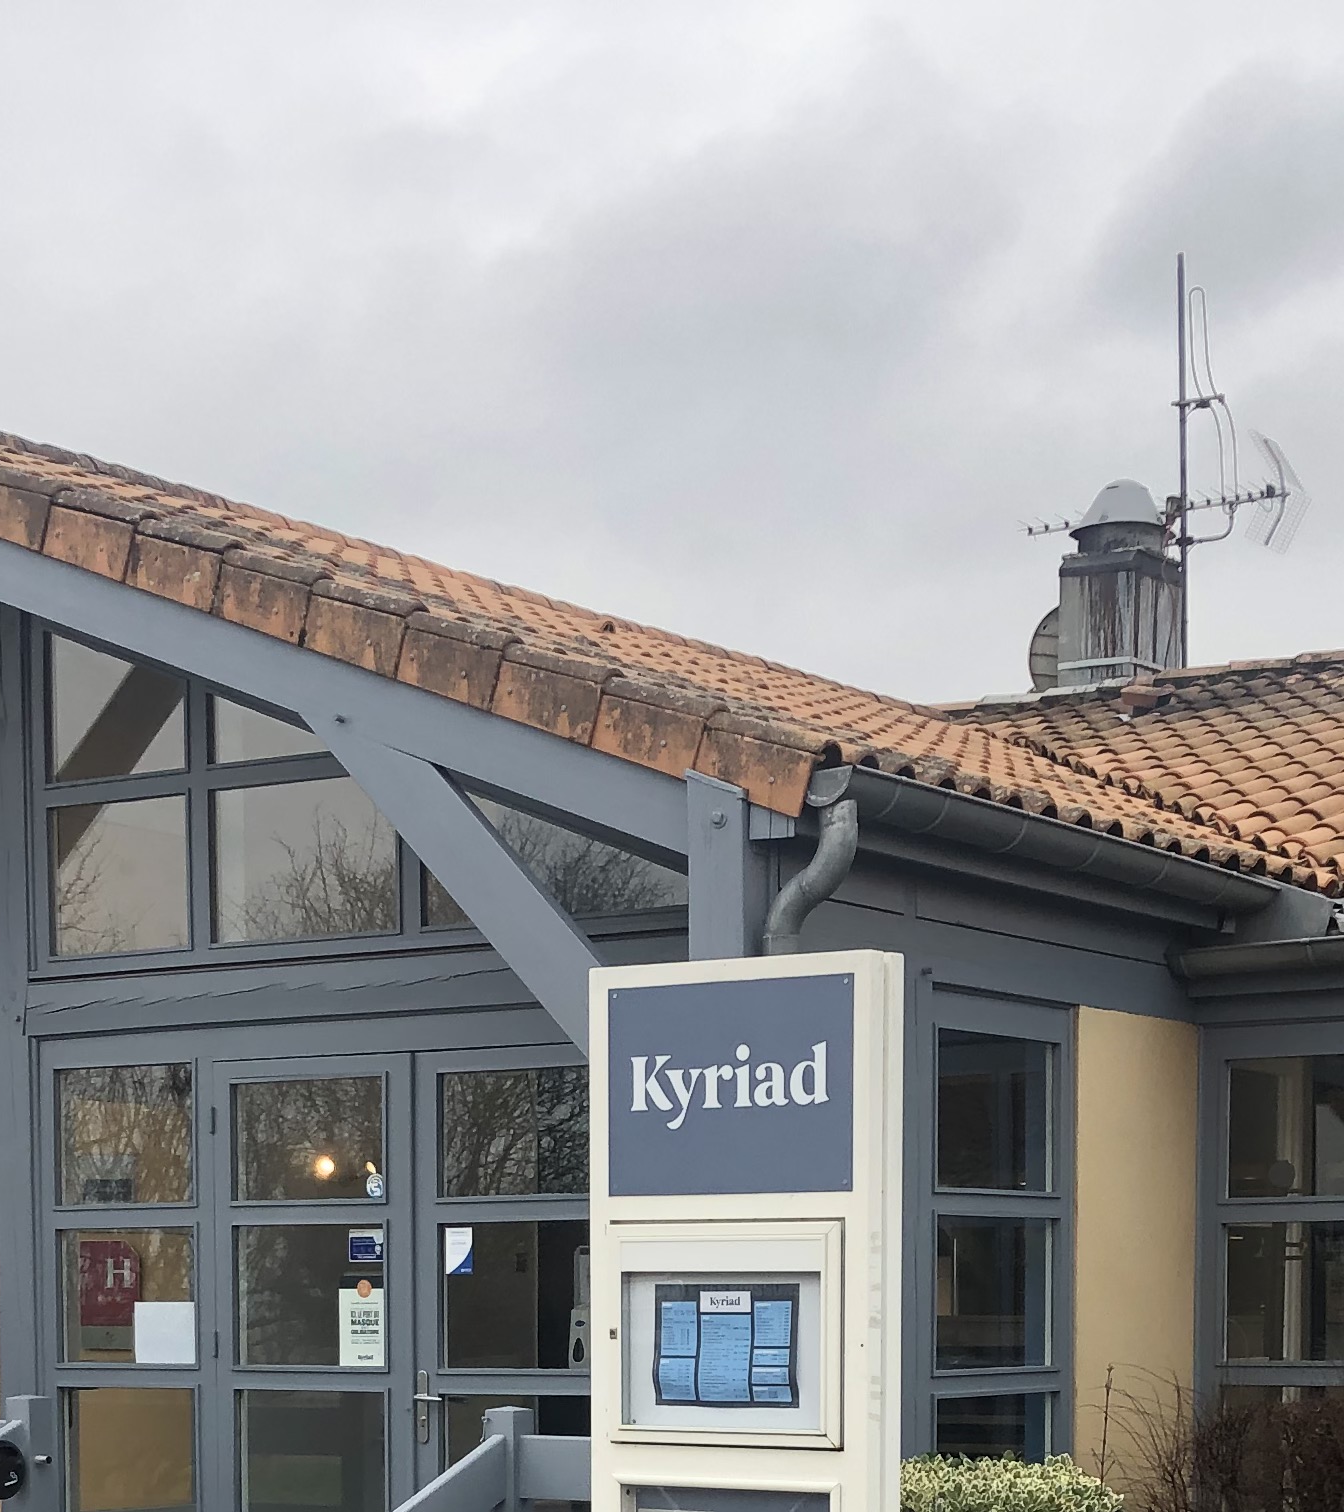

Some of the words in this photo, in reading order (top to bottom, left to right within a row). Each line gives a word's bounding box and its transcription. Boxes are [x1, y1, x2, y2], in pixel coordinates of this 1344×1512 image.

[630, 1040, 829, 1130] Kyriad
[105, 1258, 133, 1288] H
[709, 1295, 741, 1309] Kyriad
